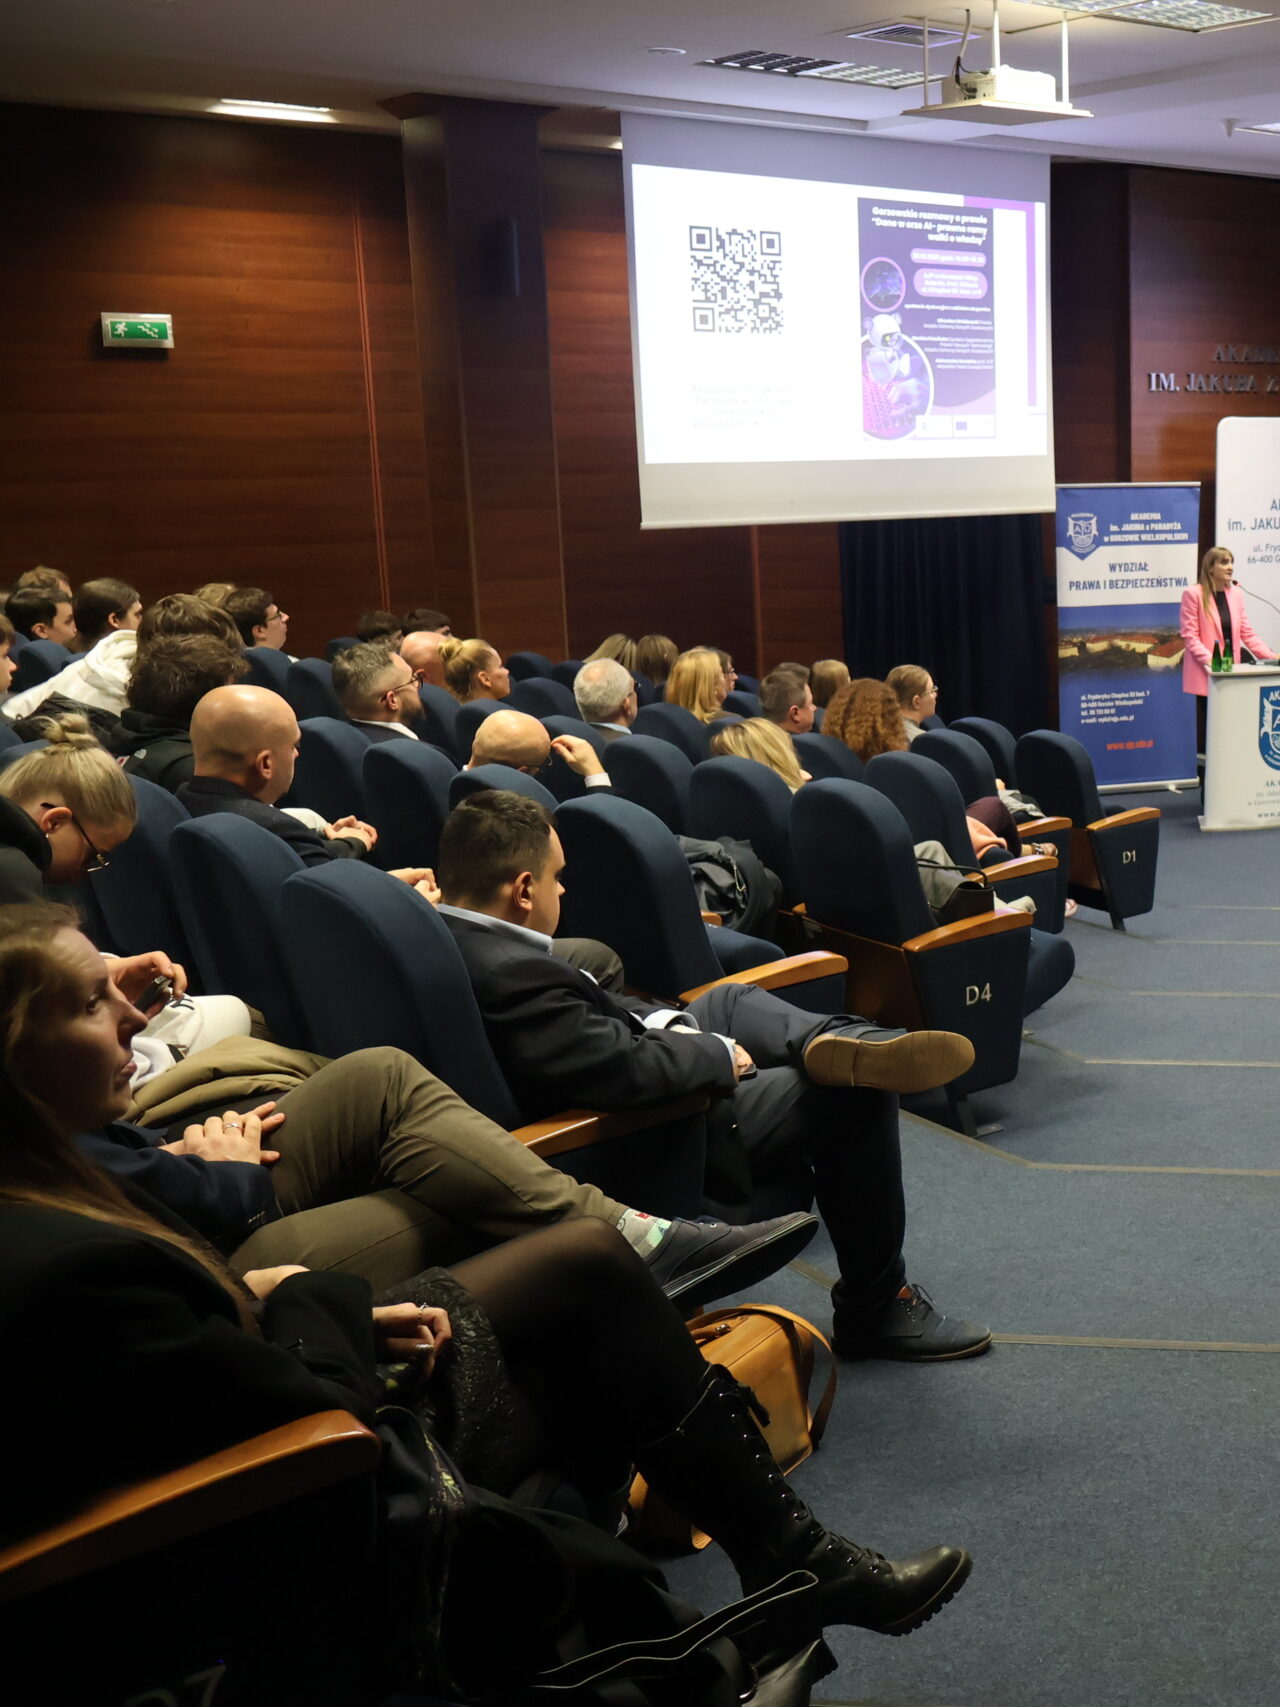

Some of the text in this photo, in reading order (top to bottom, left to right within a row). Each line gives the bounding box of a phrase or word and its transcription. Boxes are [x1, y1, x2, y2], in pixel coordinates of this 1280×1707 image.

[1148, 372, 1180, 392] IM.
[1185, 373, 1259, 392] JAKUBA
[1266, 375, 1280, 392] Z
[1150, 521, 1182, 530] PARADYŻA
[1228, 518, 1246, 531] im.
[1254, 544, 1262, 552] ul.
[1248, 556, 1272, 564] 66-400
[1108, 562, 1149, 573] WYDZIAŁ
[1069, 580, 1101, 591] PRAWA
[1108, 576, 1188, 589] BEZPIECZEŃSTWA
[1122, 850, 1136, 864] D1
[966, 982, 992, 1006] D4
